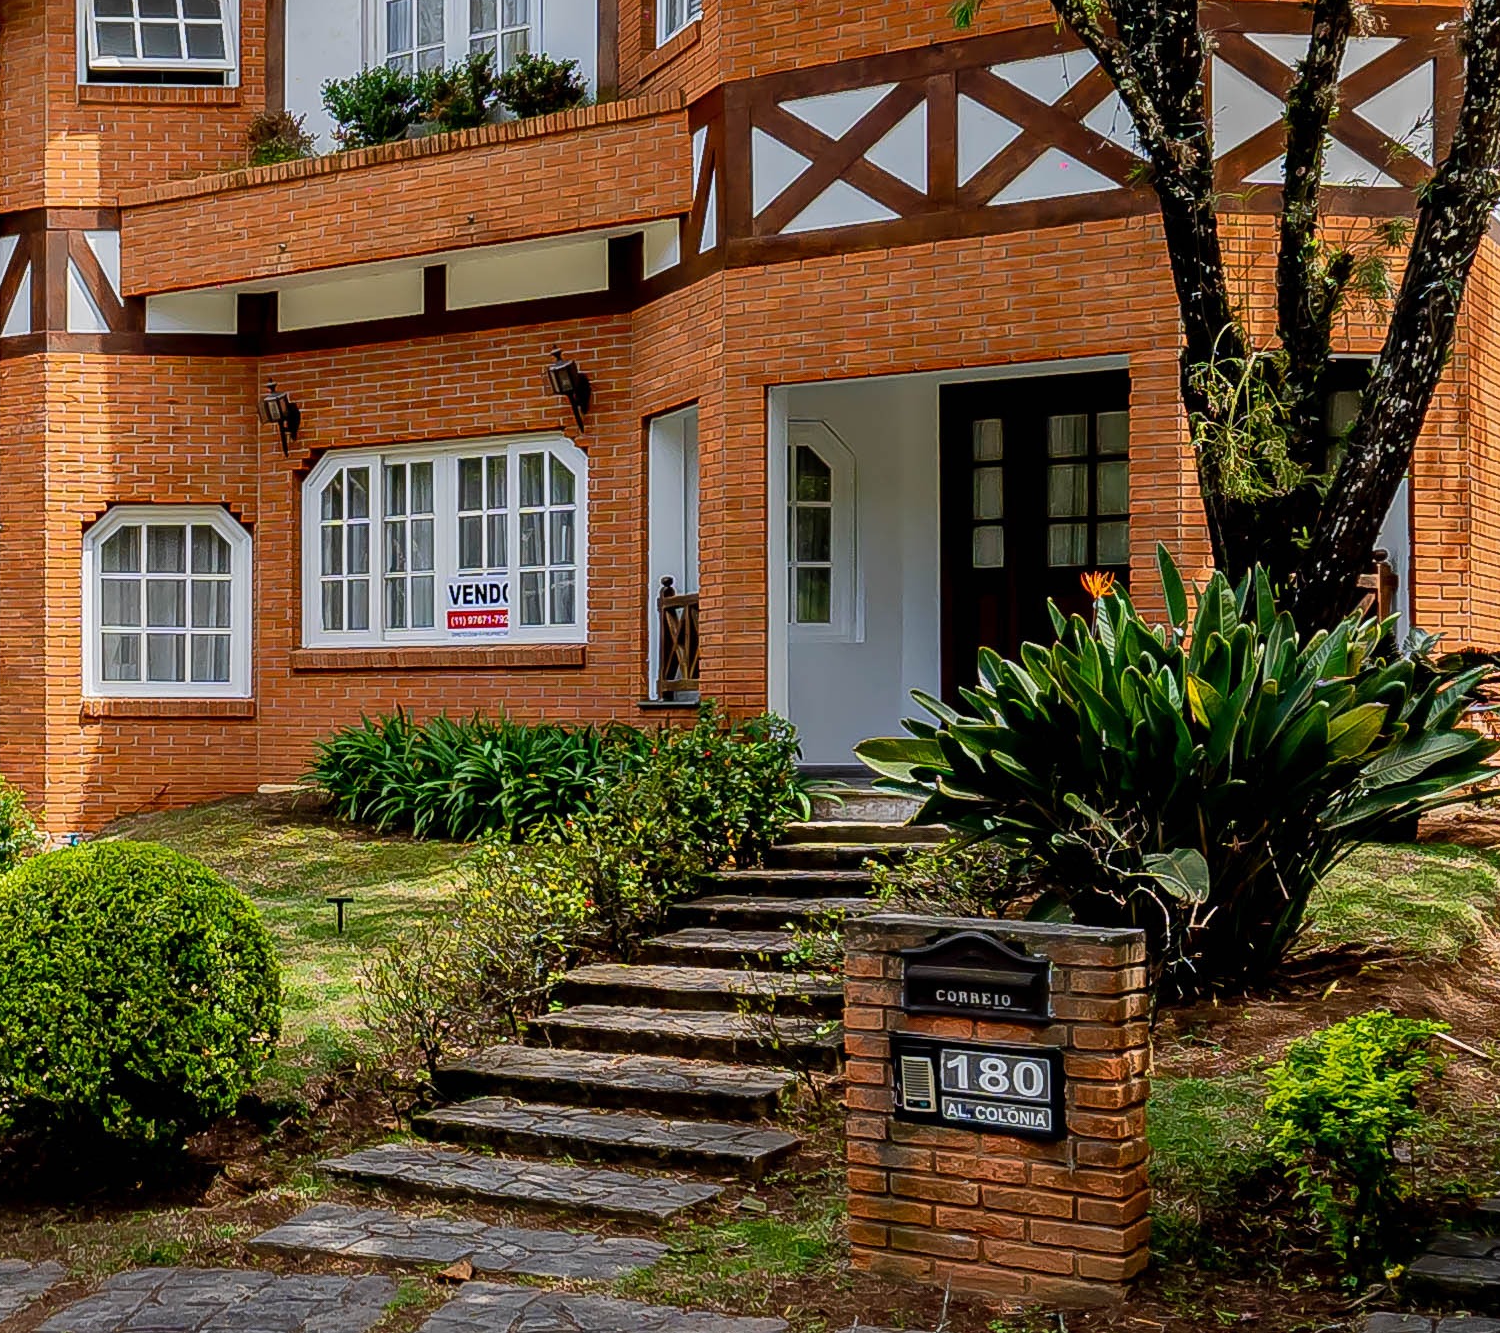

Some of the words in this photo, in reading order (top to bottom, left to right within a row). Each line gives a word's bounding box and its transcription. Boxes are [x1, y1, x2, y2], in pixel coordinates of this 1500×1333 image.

[451, 616, 466, 627] (11)
[936, 989, 1011, 1006] CORREIO
[947, 1054, 1043, 1096] 180
[947, 1103, 971, 1118] AL.
